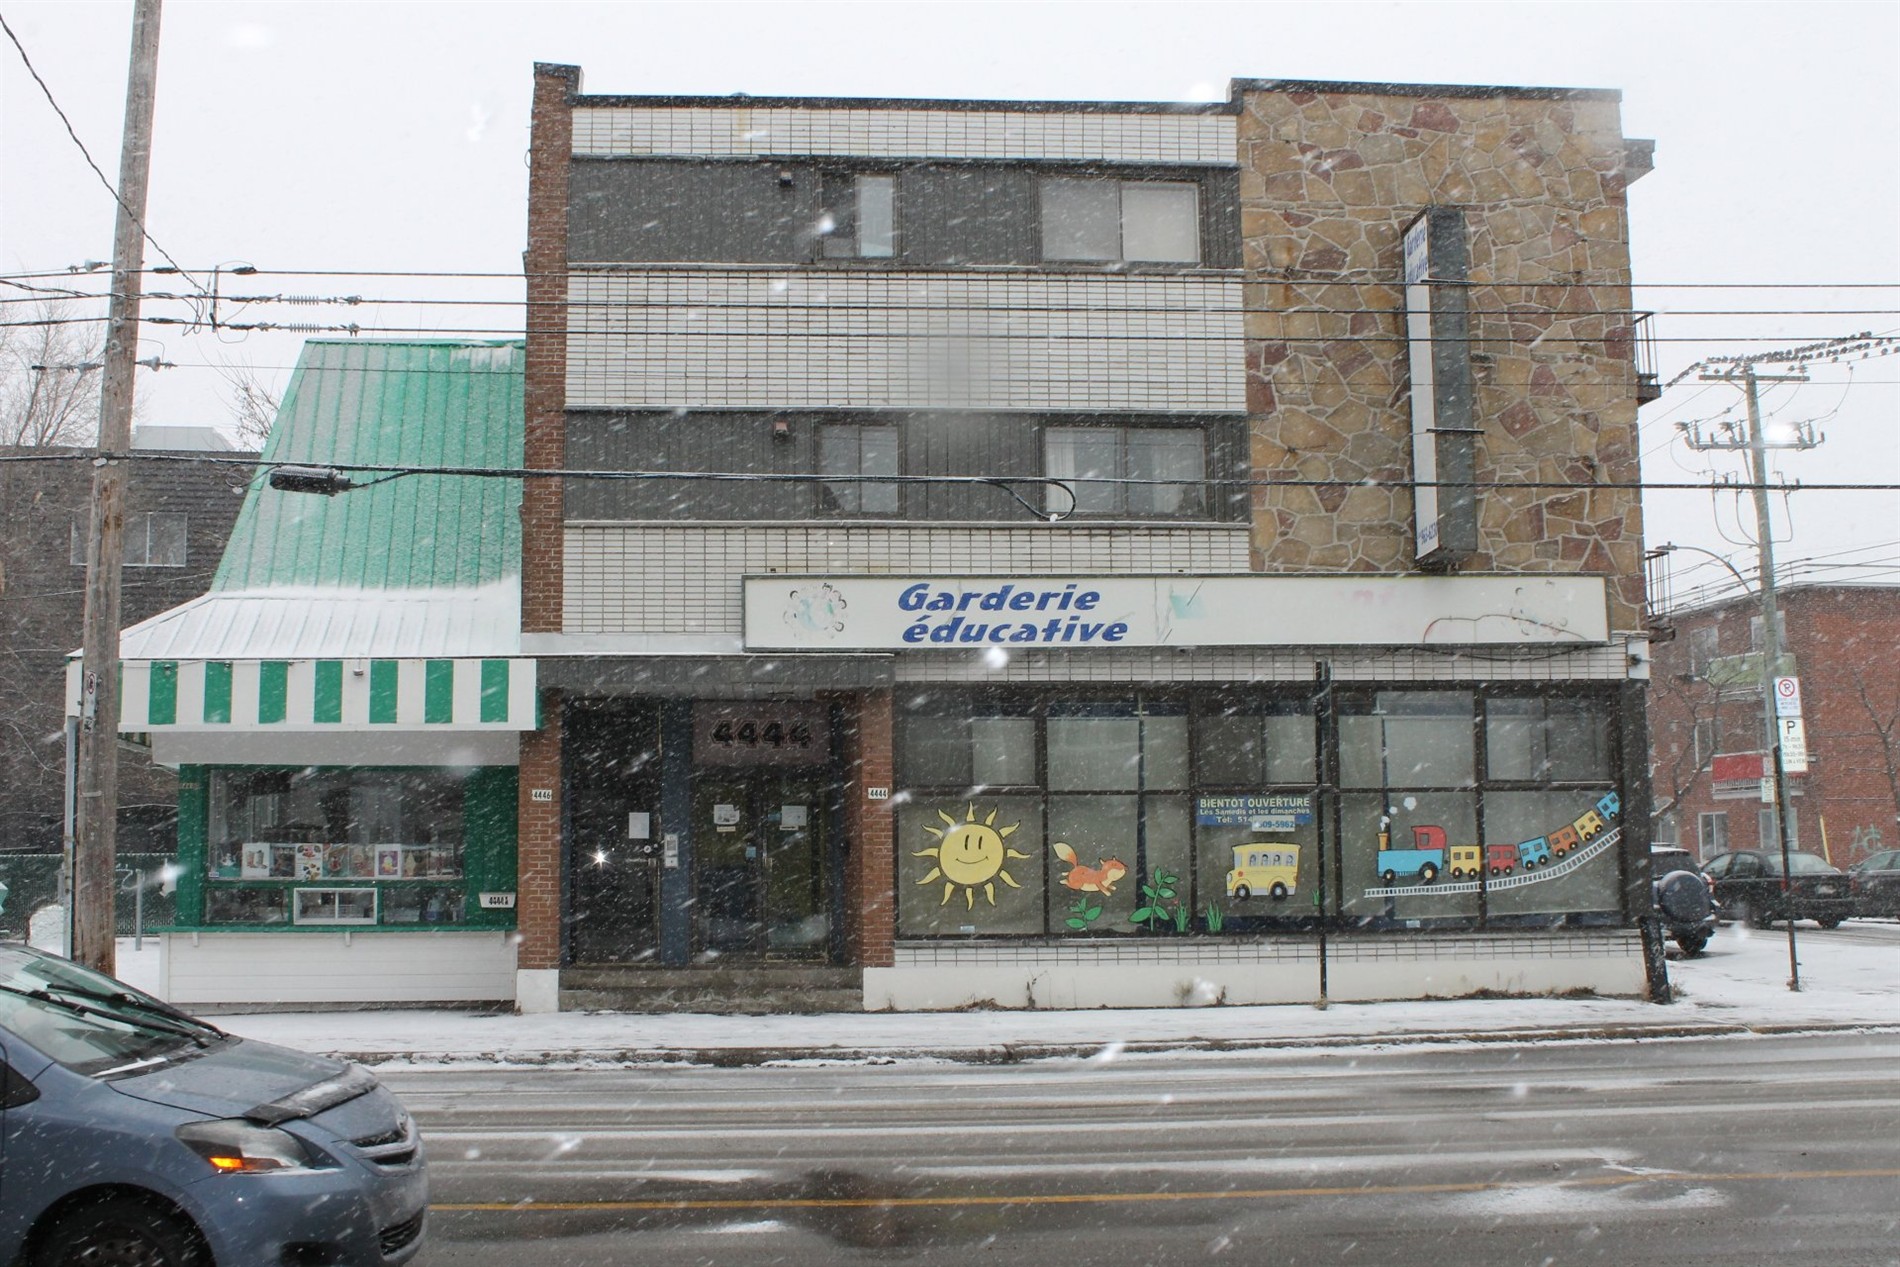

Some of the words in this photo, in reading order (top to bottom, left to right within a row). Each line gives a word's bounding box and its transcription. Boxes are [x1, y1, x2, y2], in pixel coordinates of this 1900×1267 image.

[898, 583, 1100, 611] Garderie
[902, 615, 1128, 643] éducative
[1787, 720, 1795, 734] P
[710, 720, 813, 749] 4444
[534, 791, 551, 799] 4446
[870, 789, 887, 797] 4444
[1247, 797, 1310, 807] OUVERTURE
[1270, 807, 1310, 815] dimanches
